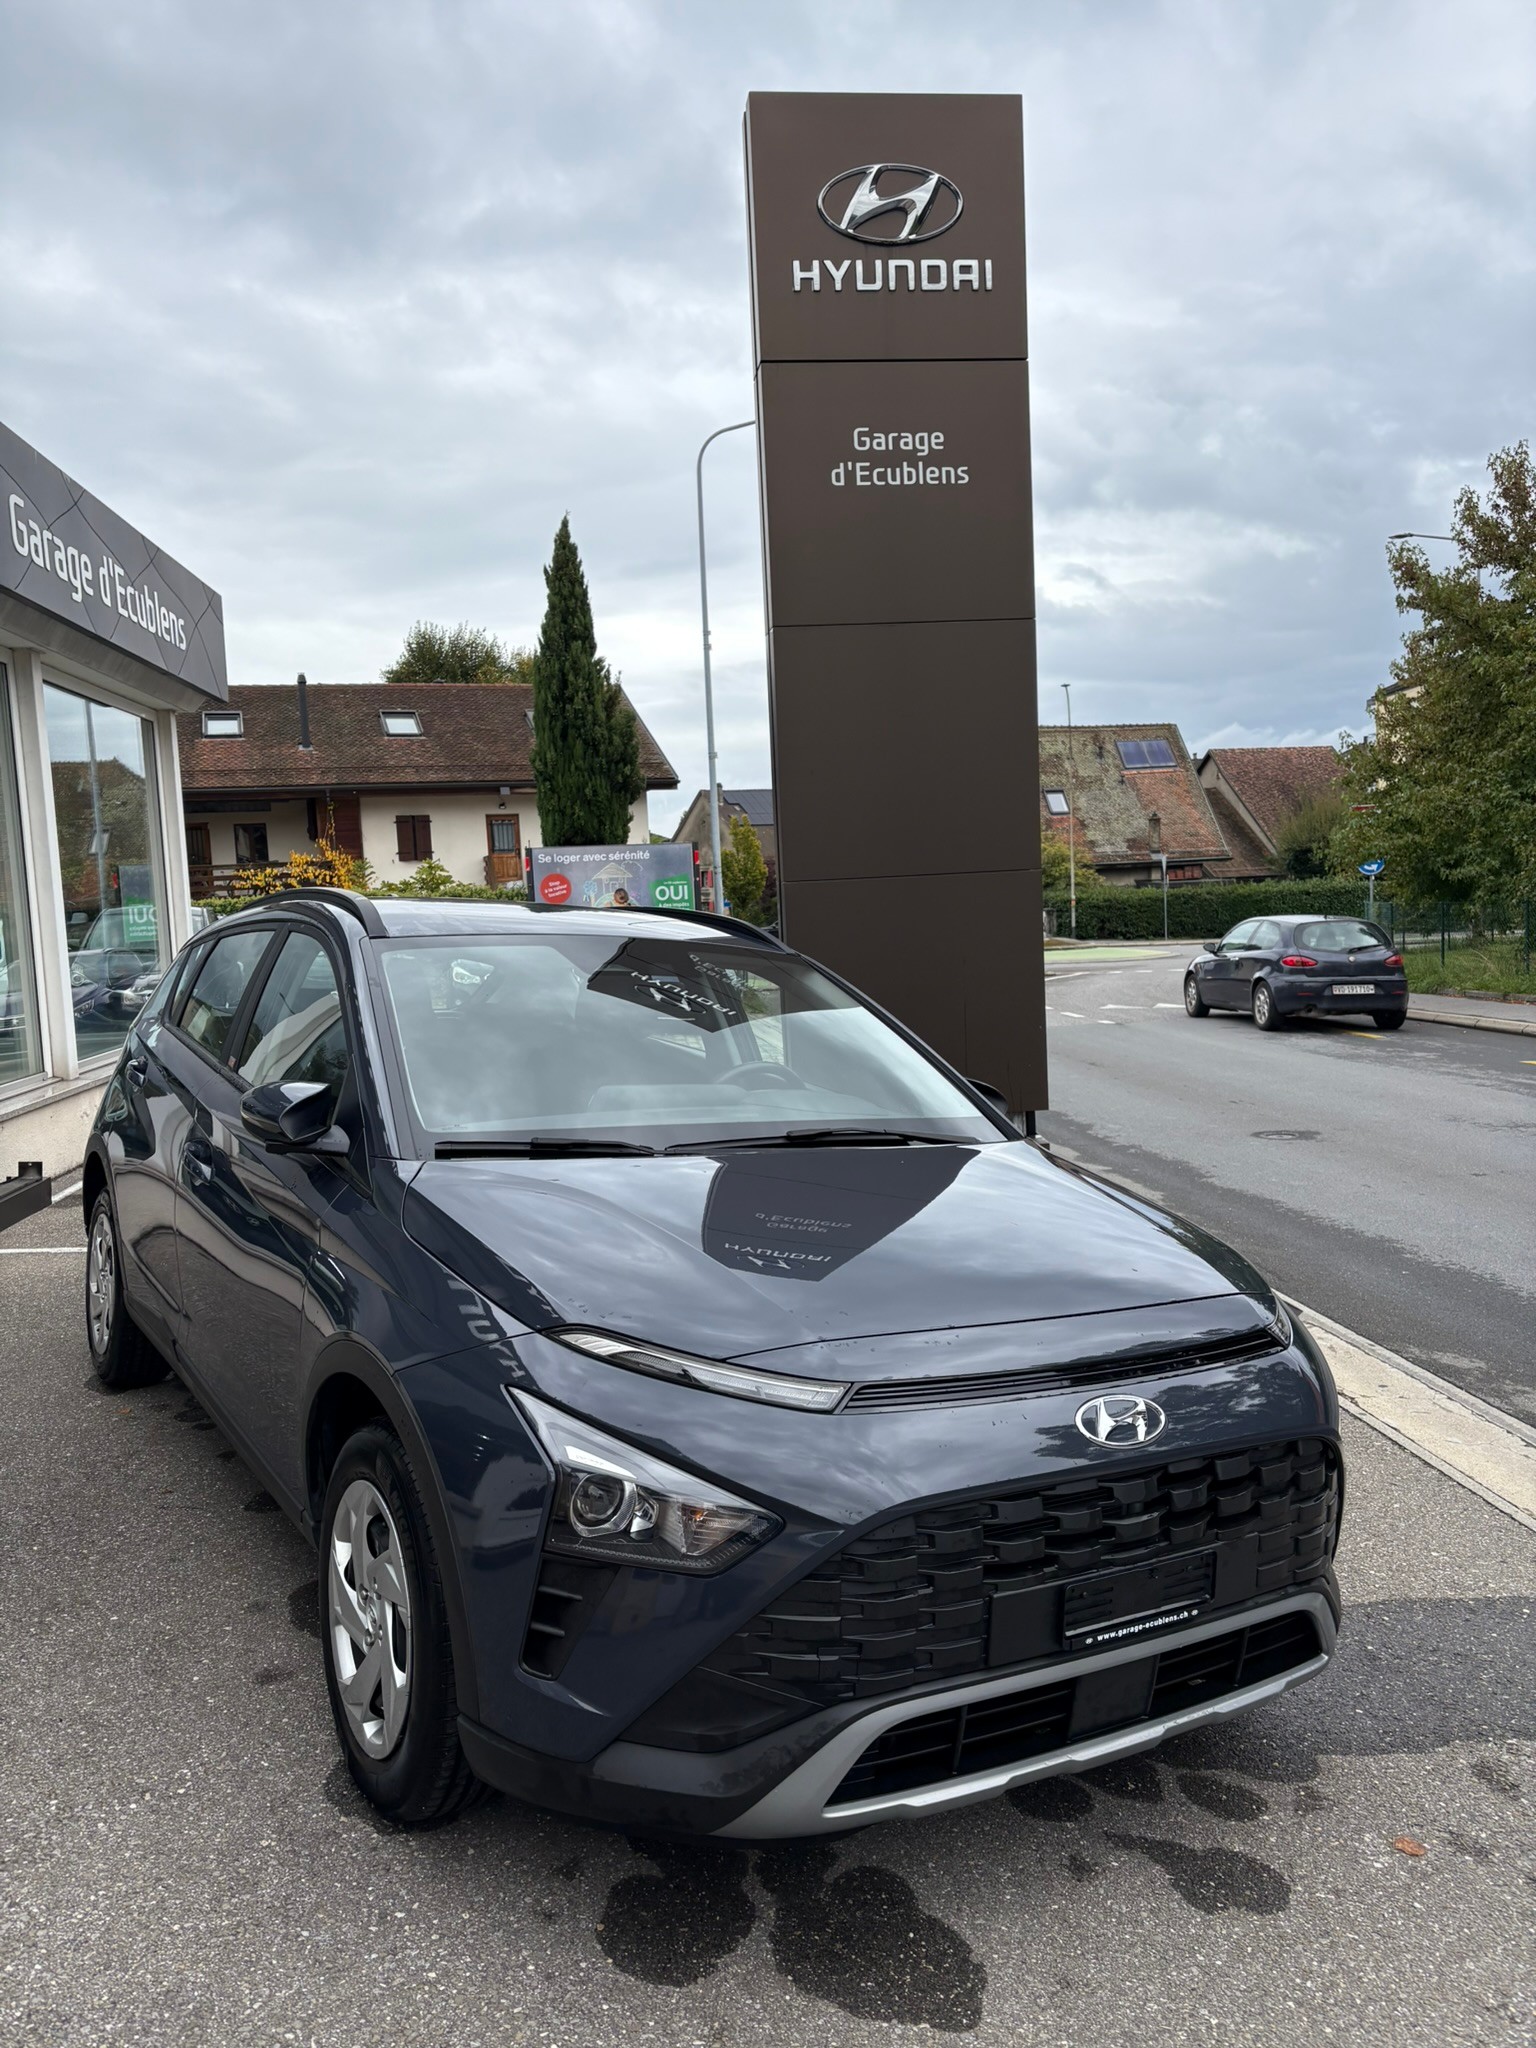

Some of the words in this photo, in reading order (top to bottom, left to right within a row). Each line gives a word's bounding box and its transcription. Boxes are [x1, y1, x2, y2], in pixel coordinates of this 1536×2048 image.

[792, 258, 993, 292] HYUNDAI
[853, 427, 945, 456] Garage
[831, 462, 969, 486] d'Ecublens
[9, 493, 94, 603] Garage
[99, 555, 187, 651] d'Ecublens
[538, 854, 551, 864] Se
[554, 853, 581, 865] loger
[582, 852, 607, 862] avec
[608, 850, 650, 861] sérénité
[655, 885, 689, 901] OUI
[1097, 1610, 1188, 1641] www.garage-ecublens.ch
